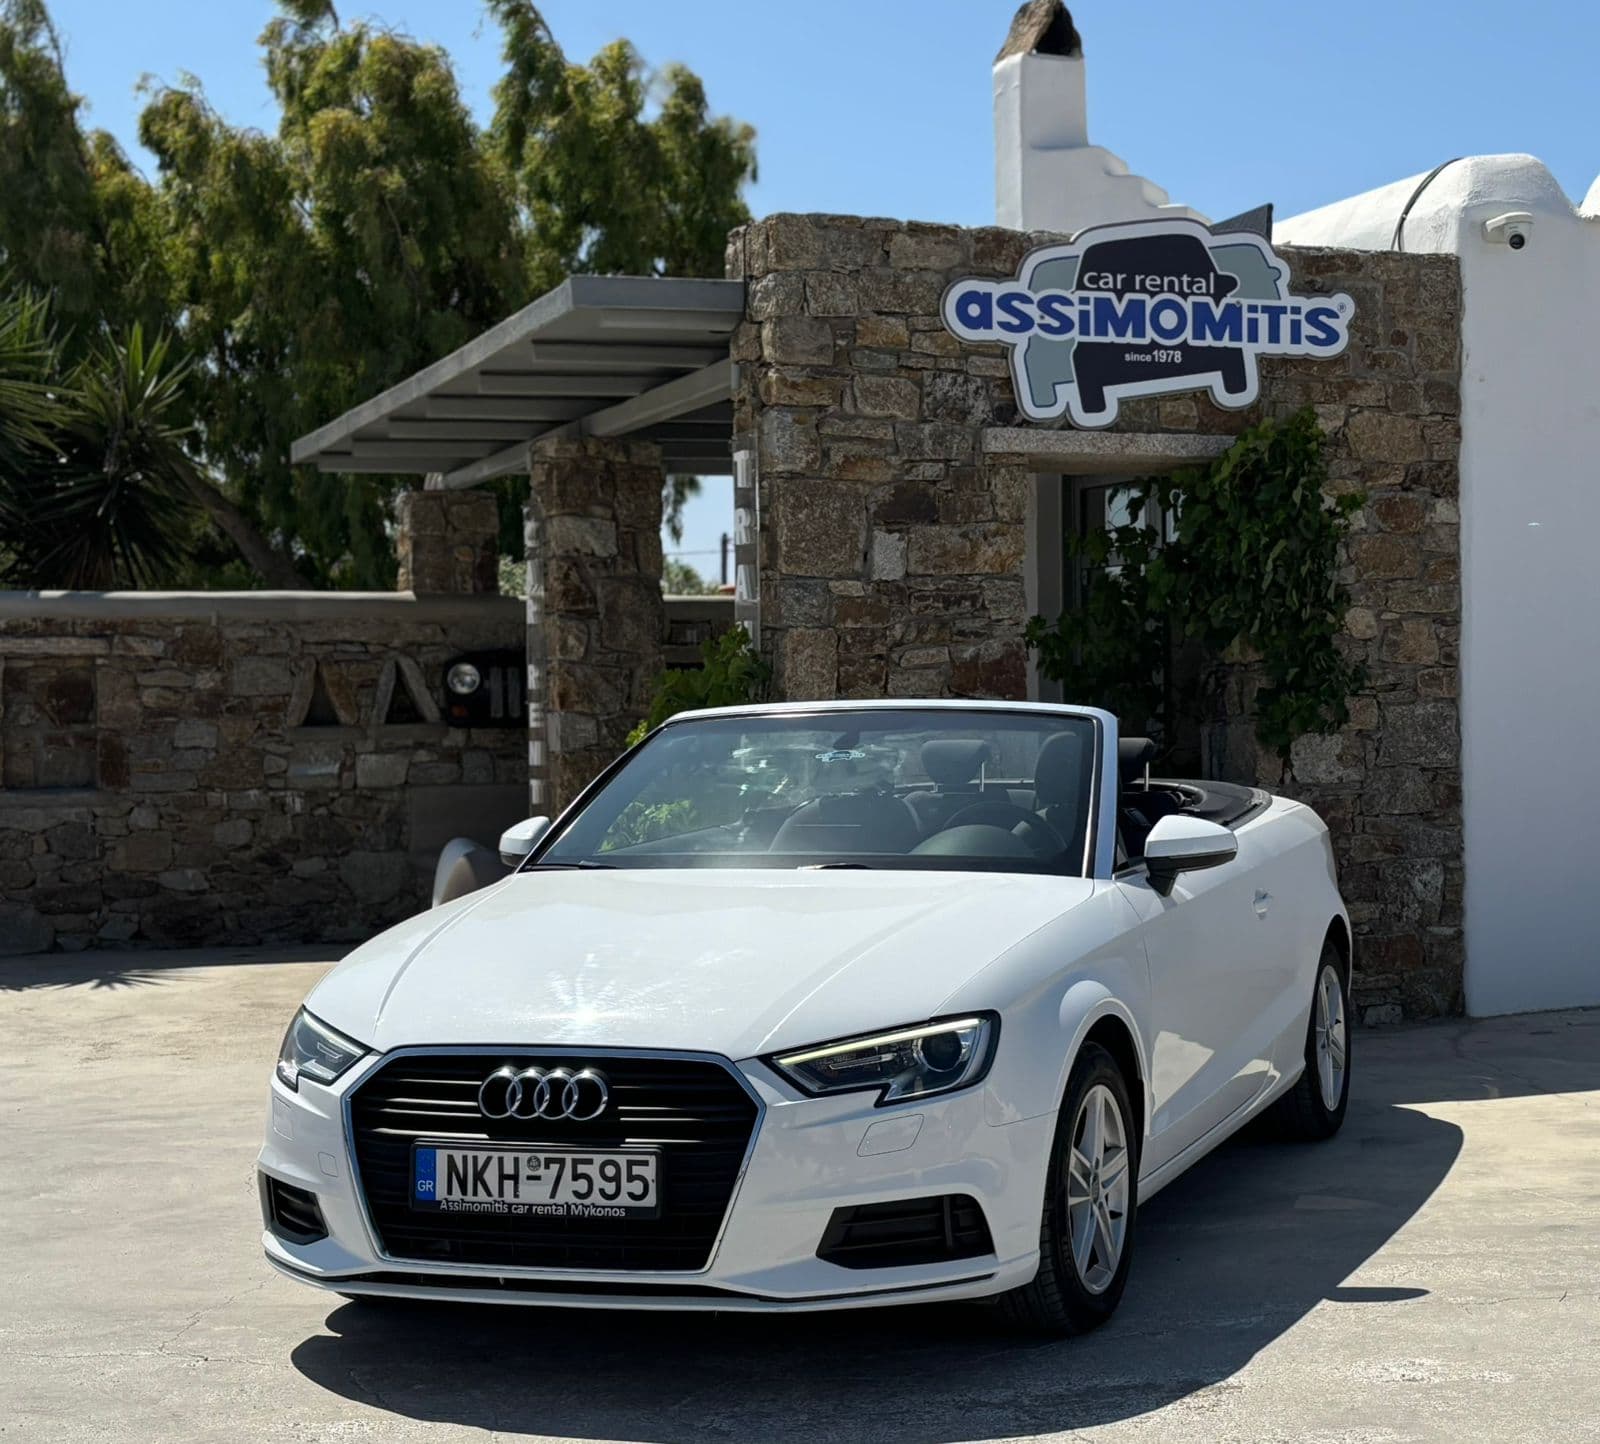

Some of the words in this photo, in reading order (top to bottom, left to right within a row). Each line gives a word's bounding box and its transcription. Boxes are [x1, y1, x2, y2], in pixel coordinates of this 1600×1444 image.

[1083, 271, 1127, 289] car
[1135, 271, 1214, 294] rental
[417, 1179, 434, 1192] GR
[440, 1199, 509, 1214] Assimomitis
[511, 1203, 529, 1214] car
[532, 1202, 567, 1216] rental
[570, 1204, 626, 1218] Mykonos
